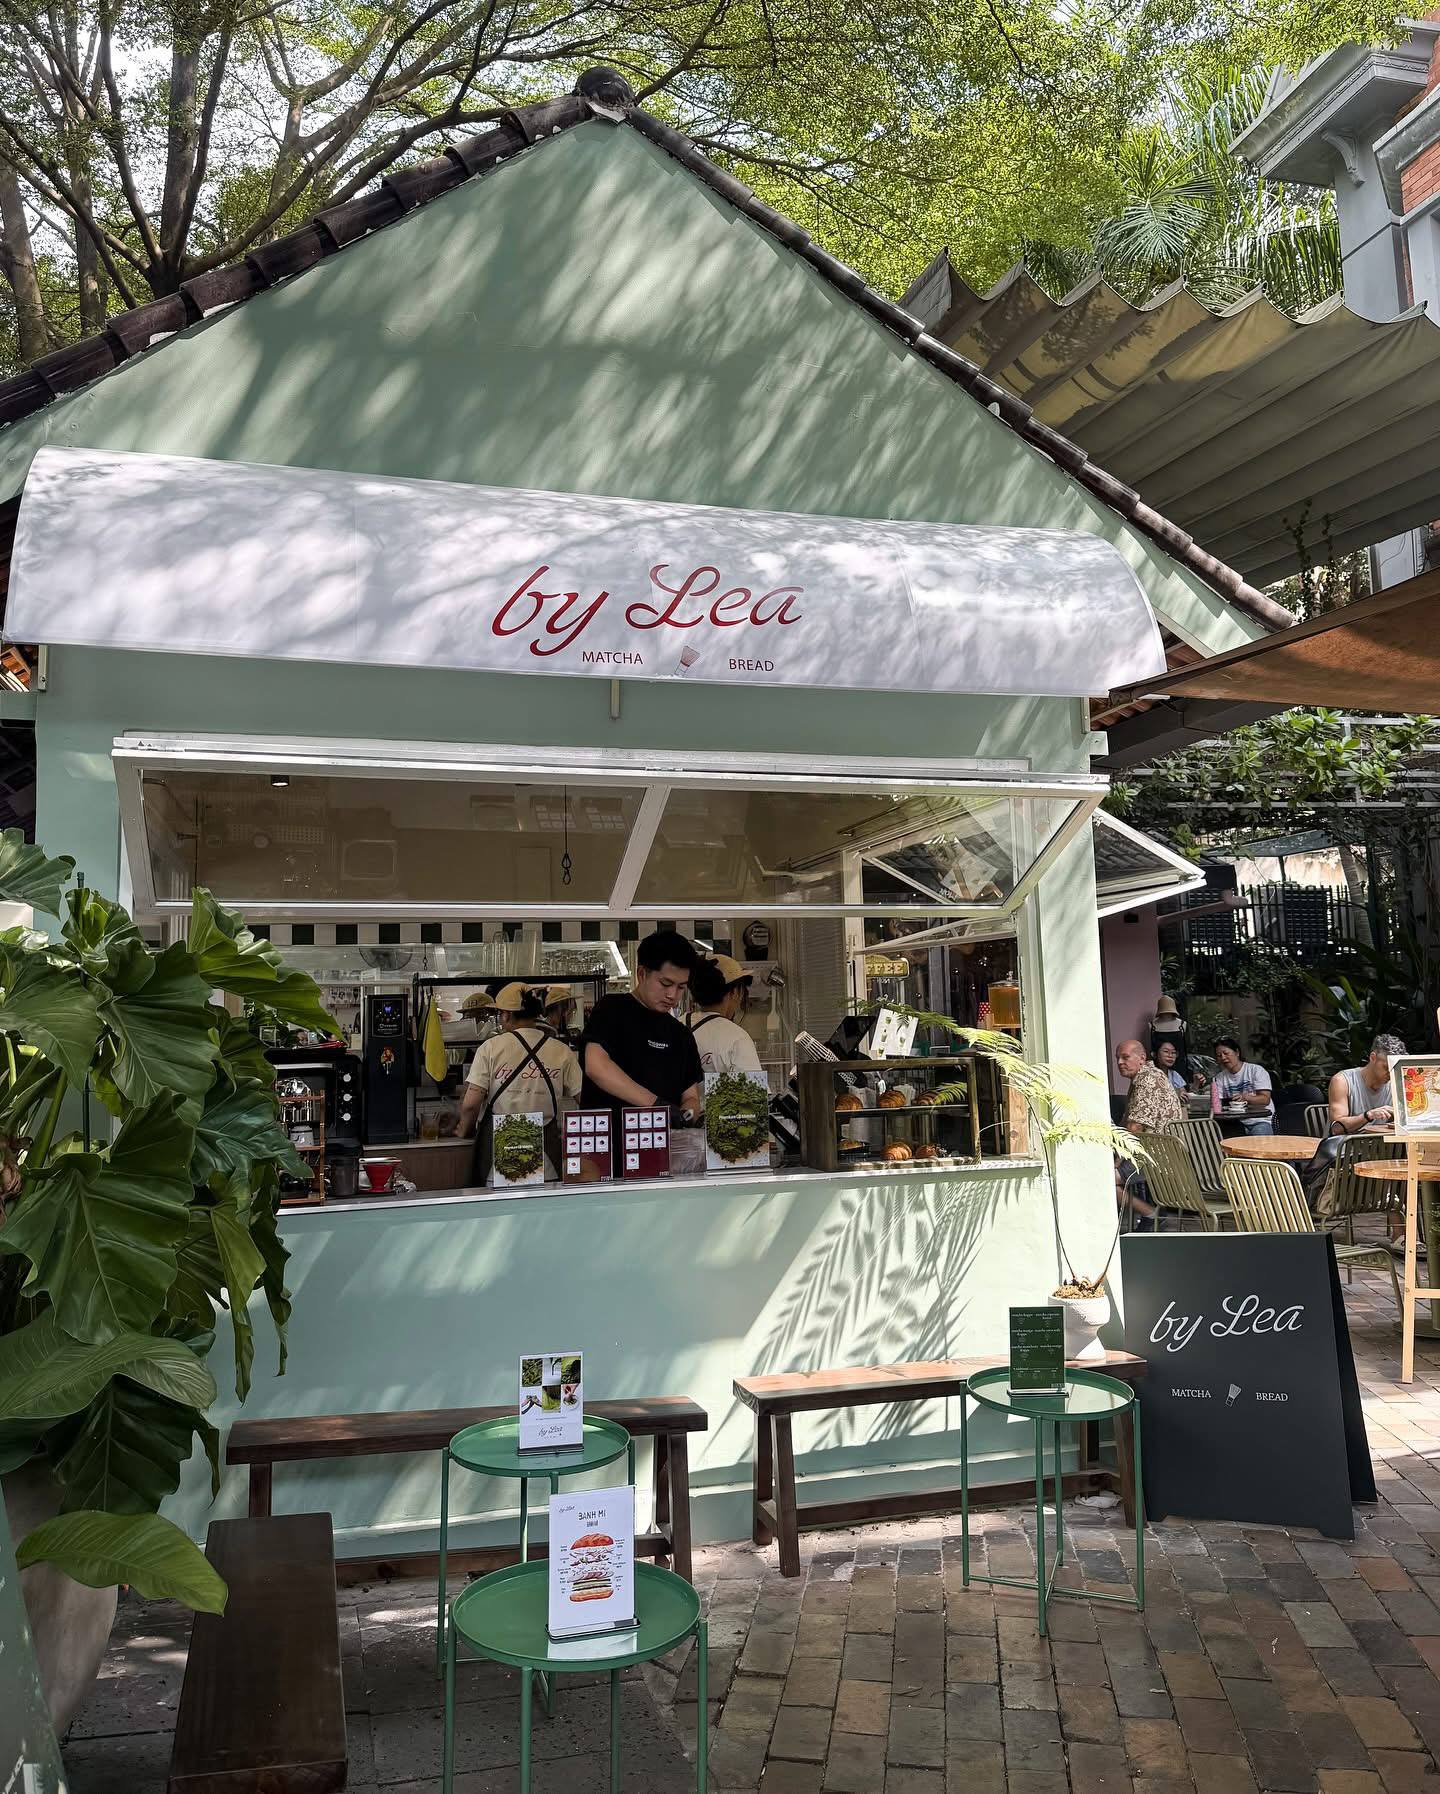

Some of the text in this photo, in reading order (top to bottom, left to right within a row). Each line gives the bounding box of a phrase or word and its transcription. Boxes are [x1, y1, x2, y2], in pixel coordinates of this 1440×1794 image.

[492, 564, 804, 656] by Lea
[582, 650, 774, 672] MATCHA BREAD
[865, 963, 903, 975] FFEE
[1150, 1294, 1304, 1352] by Lea
[1172, 1388, 1288, 1402] MATCHA BREAD
